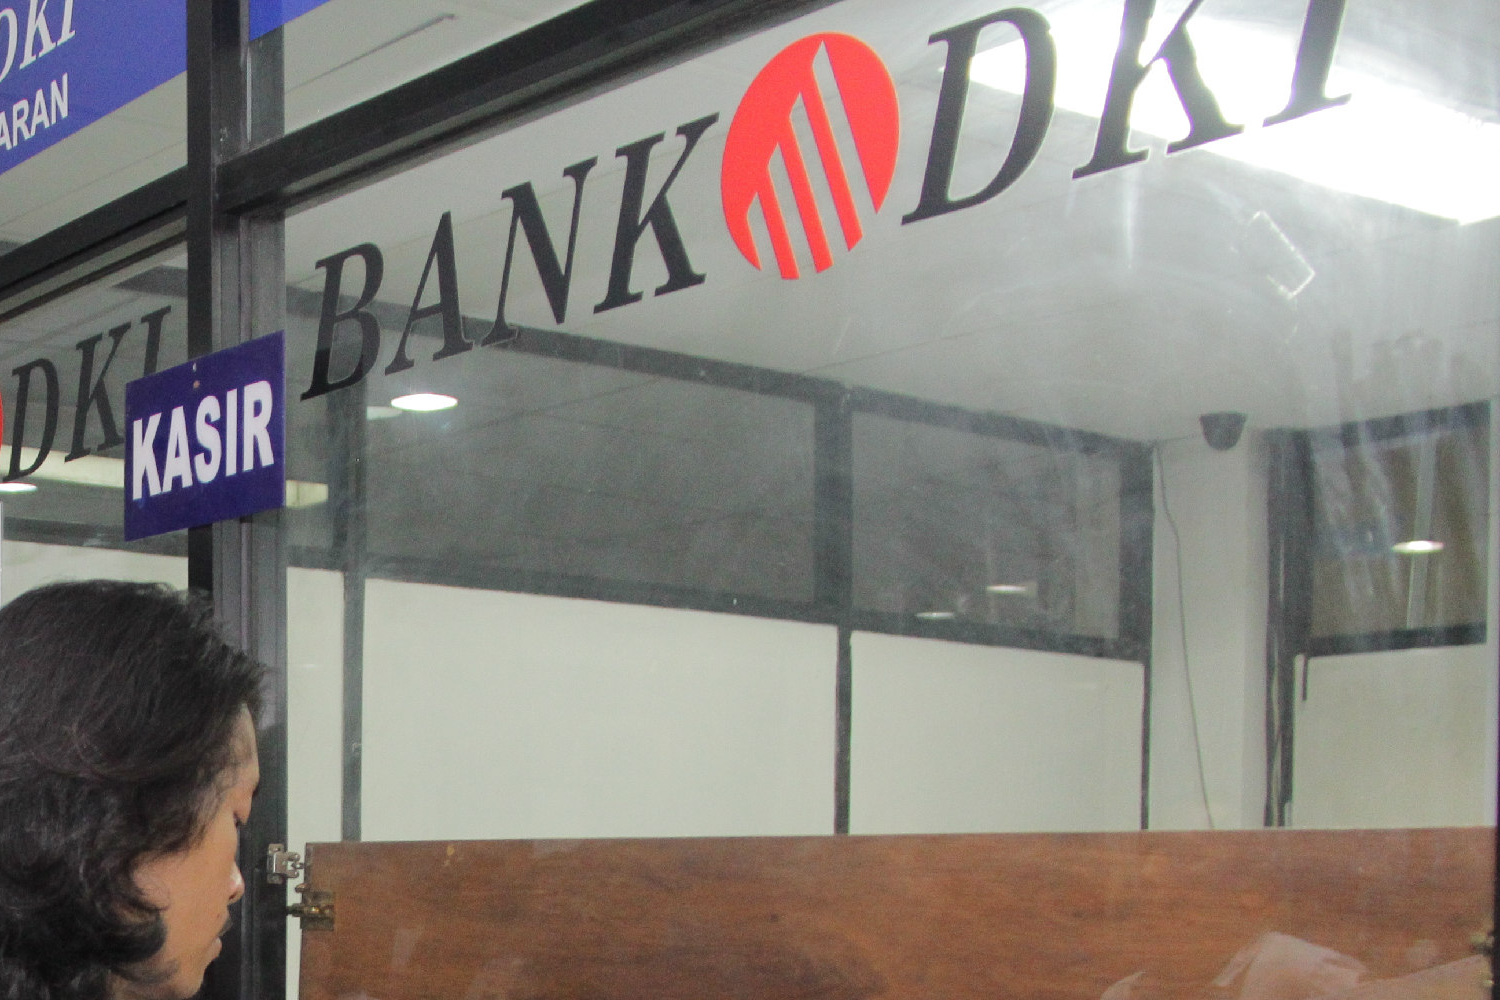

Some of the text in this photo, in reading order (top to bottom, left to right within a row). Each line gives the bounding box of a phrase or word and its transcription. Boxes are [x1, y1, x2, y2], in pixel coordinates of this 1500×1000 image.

[300, 0, 1352, 401] BANK DKI
[3, 306, 172, 484] DKI
[132, 380, 275, 501] KASIR
